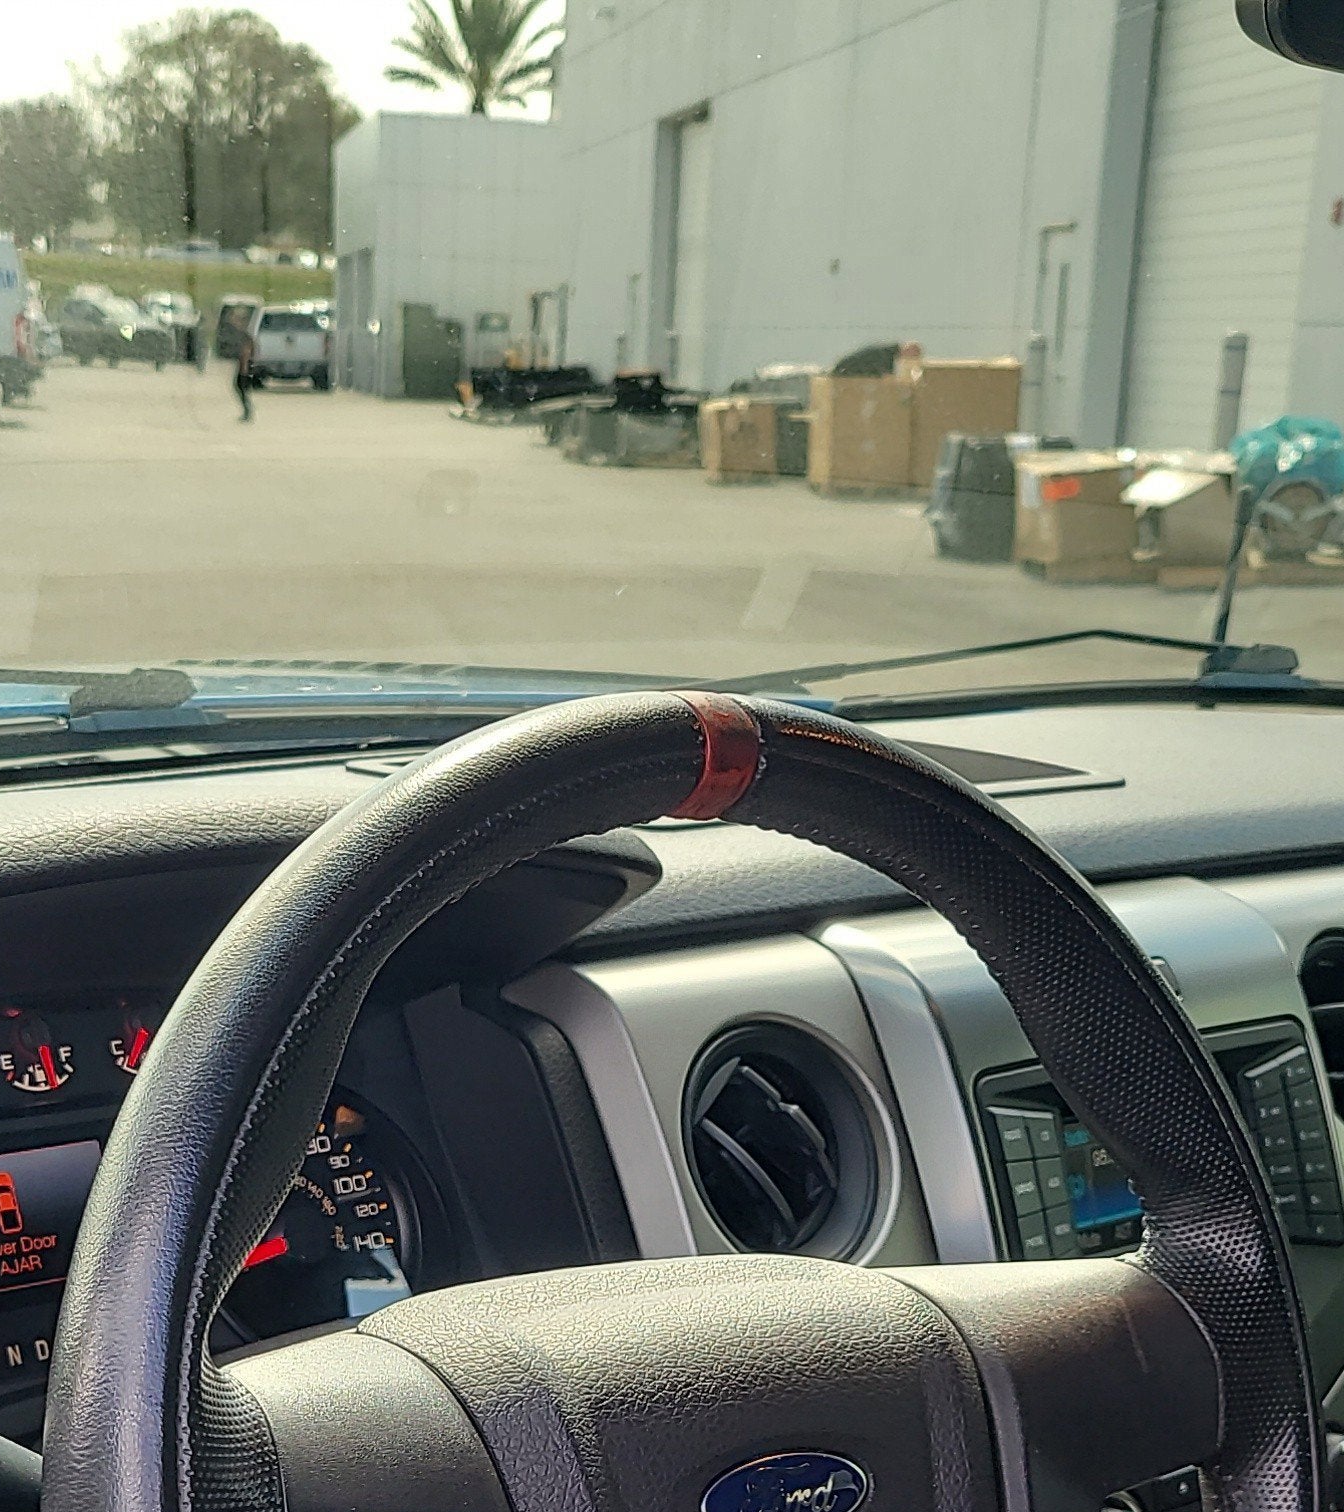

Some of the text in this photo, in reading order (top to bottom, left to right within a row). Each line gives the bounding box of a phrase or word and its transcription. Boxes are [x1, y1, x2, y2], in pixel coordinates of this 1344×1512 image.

[58, 1046, 72, 1062] F
[111, 1039, 124, 1055] C
[333, 1175, 366, 1195] 100
[355, 1203, 379, 1217] 120
[20, 1235, 57, 1252] Door
[353, 1232, 385, 1252] 140
[0, 1255, 43, 1276] AJAR
[7, 1344, 23, 1367] N
[34, 1339, 50, 1361] D
